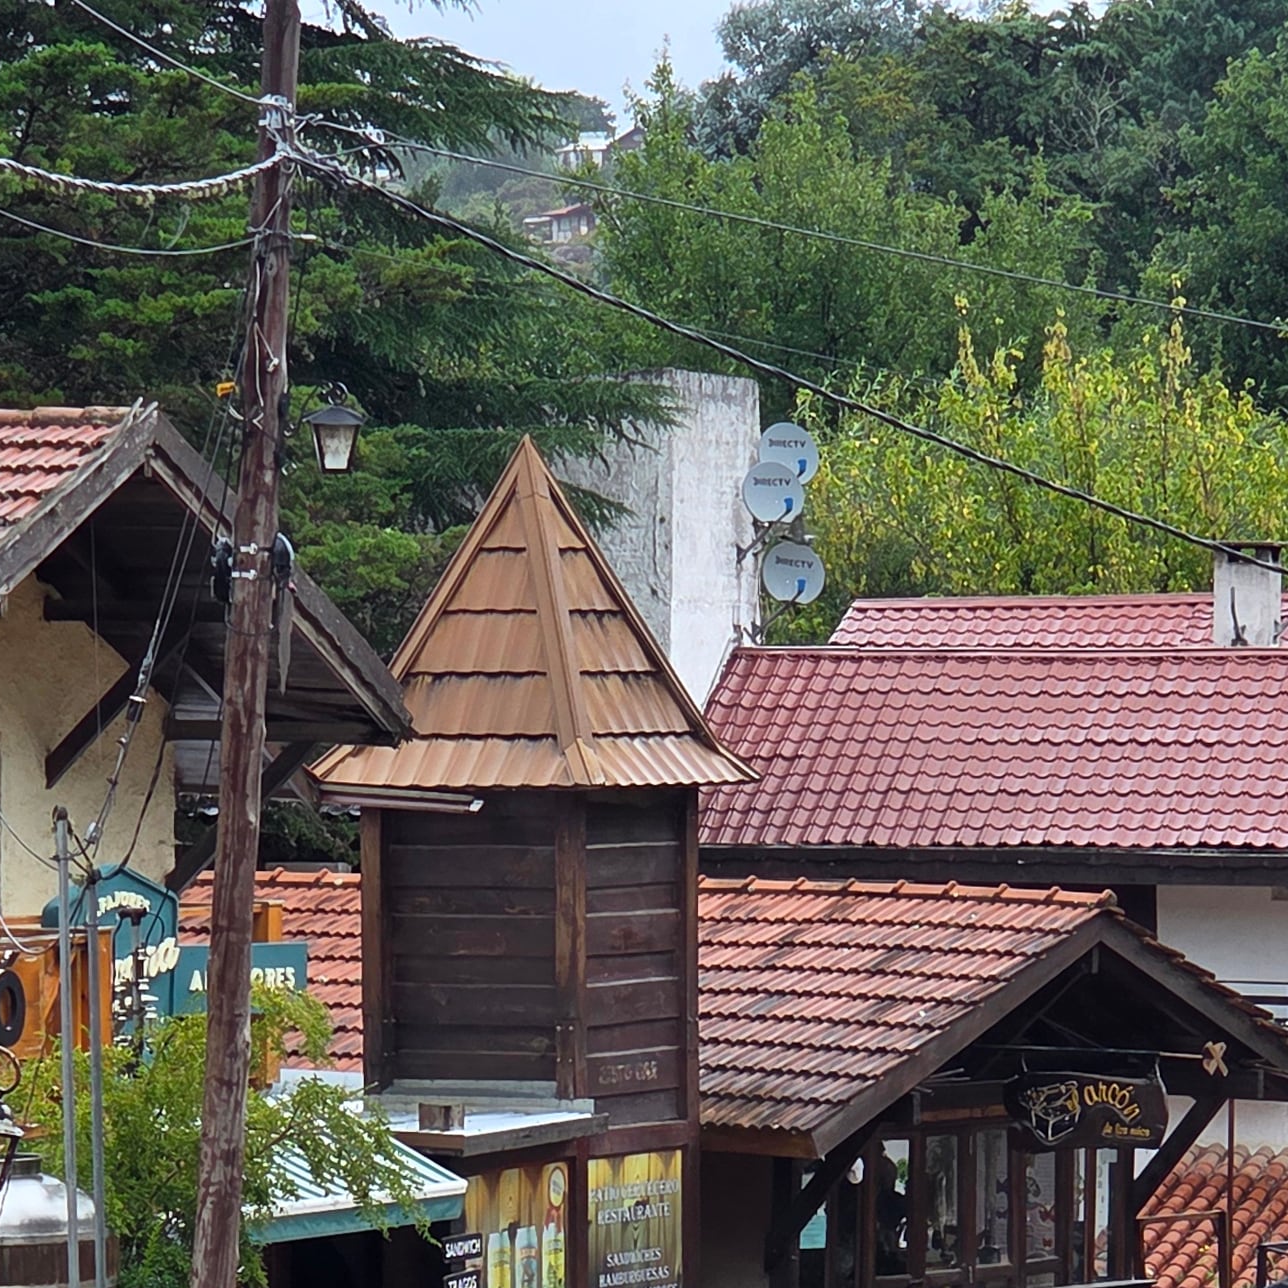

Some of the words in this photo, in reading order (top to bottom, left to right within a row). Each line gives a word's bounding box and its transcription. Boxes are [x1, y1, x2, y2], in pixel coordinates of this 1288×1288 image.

[768, 438, 806, 448] DIRECTV
[753, 477, 791, 487] DIRECTV
[775, 555, 814, 568] DIRECTV
[1083, 1081, 1141, 1124] arcón
[597, 1202, 672, 1225] RESTAURANTE
[445, 1238, 481, 1258] SANDWICH
